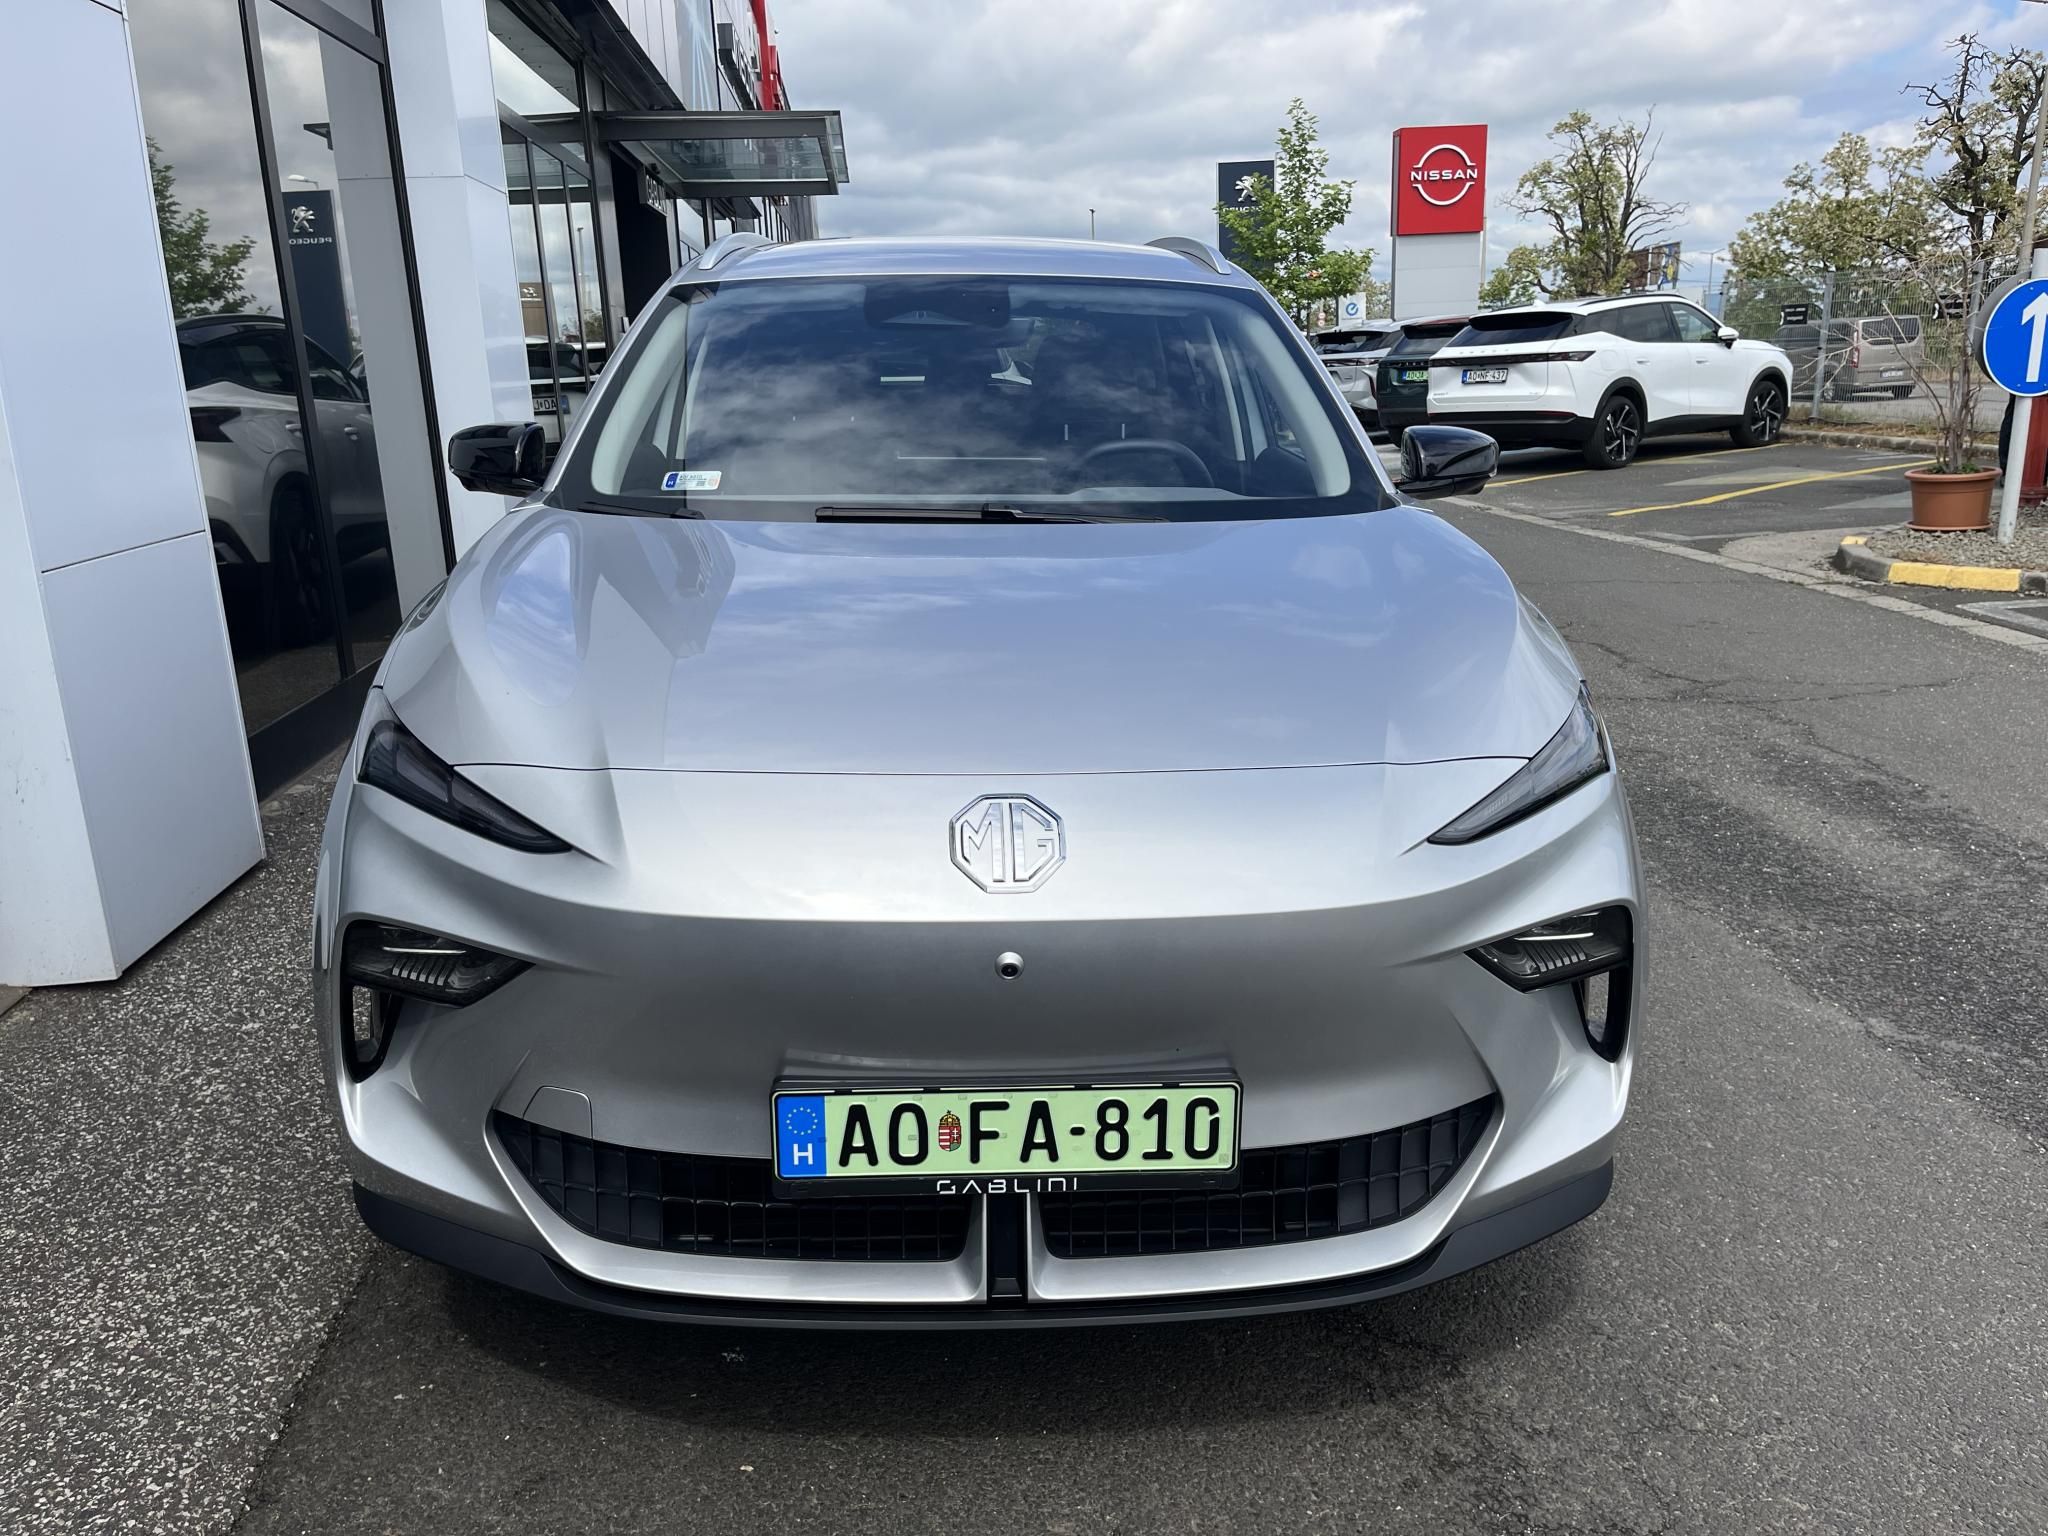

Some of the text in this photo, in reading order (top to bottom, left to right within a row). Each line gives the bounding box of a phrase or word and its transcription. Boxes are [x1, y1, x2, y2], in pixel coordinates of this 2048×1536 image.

[1410, 168, 1478, 181] NISSAN
[960, 802, 1056, 883] MG
[793, 1096, 1221, 1168] H AO FA-810
[936, 1177, 1079, 1195] GABLINI
